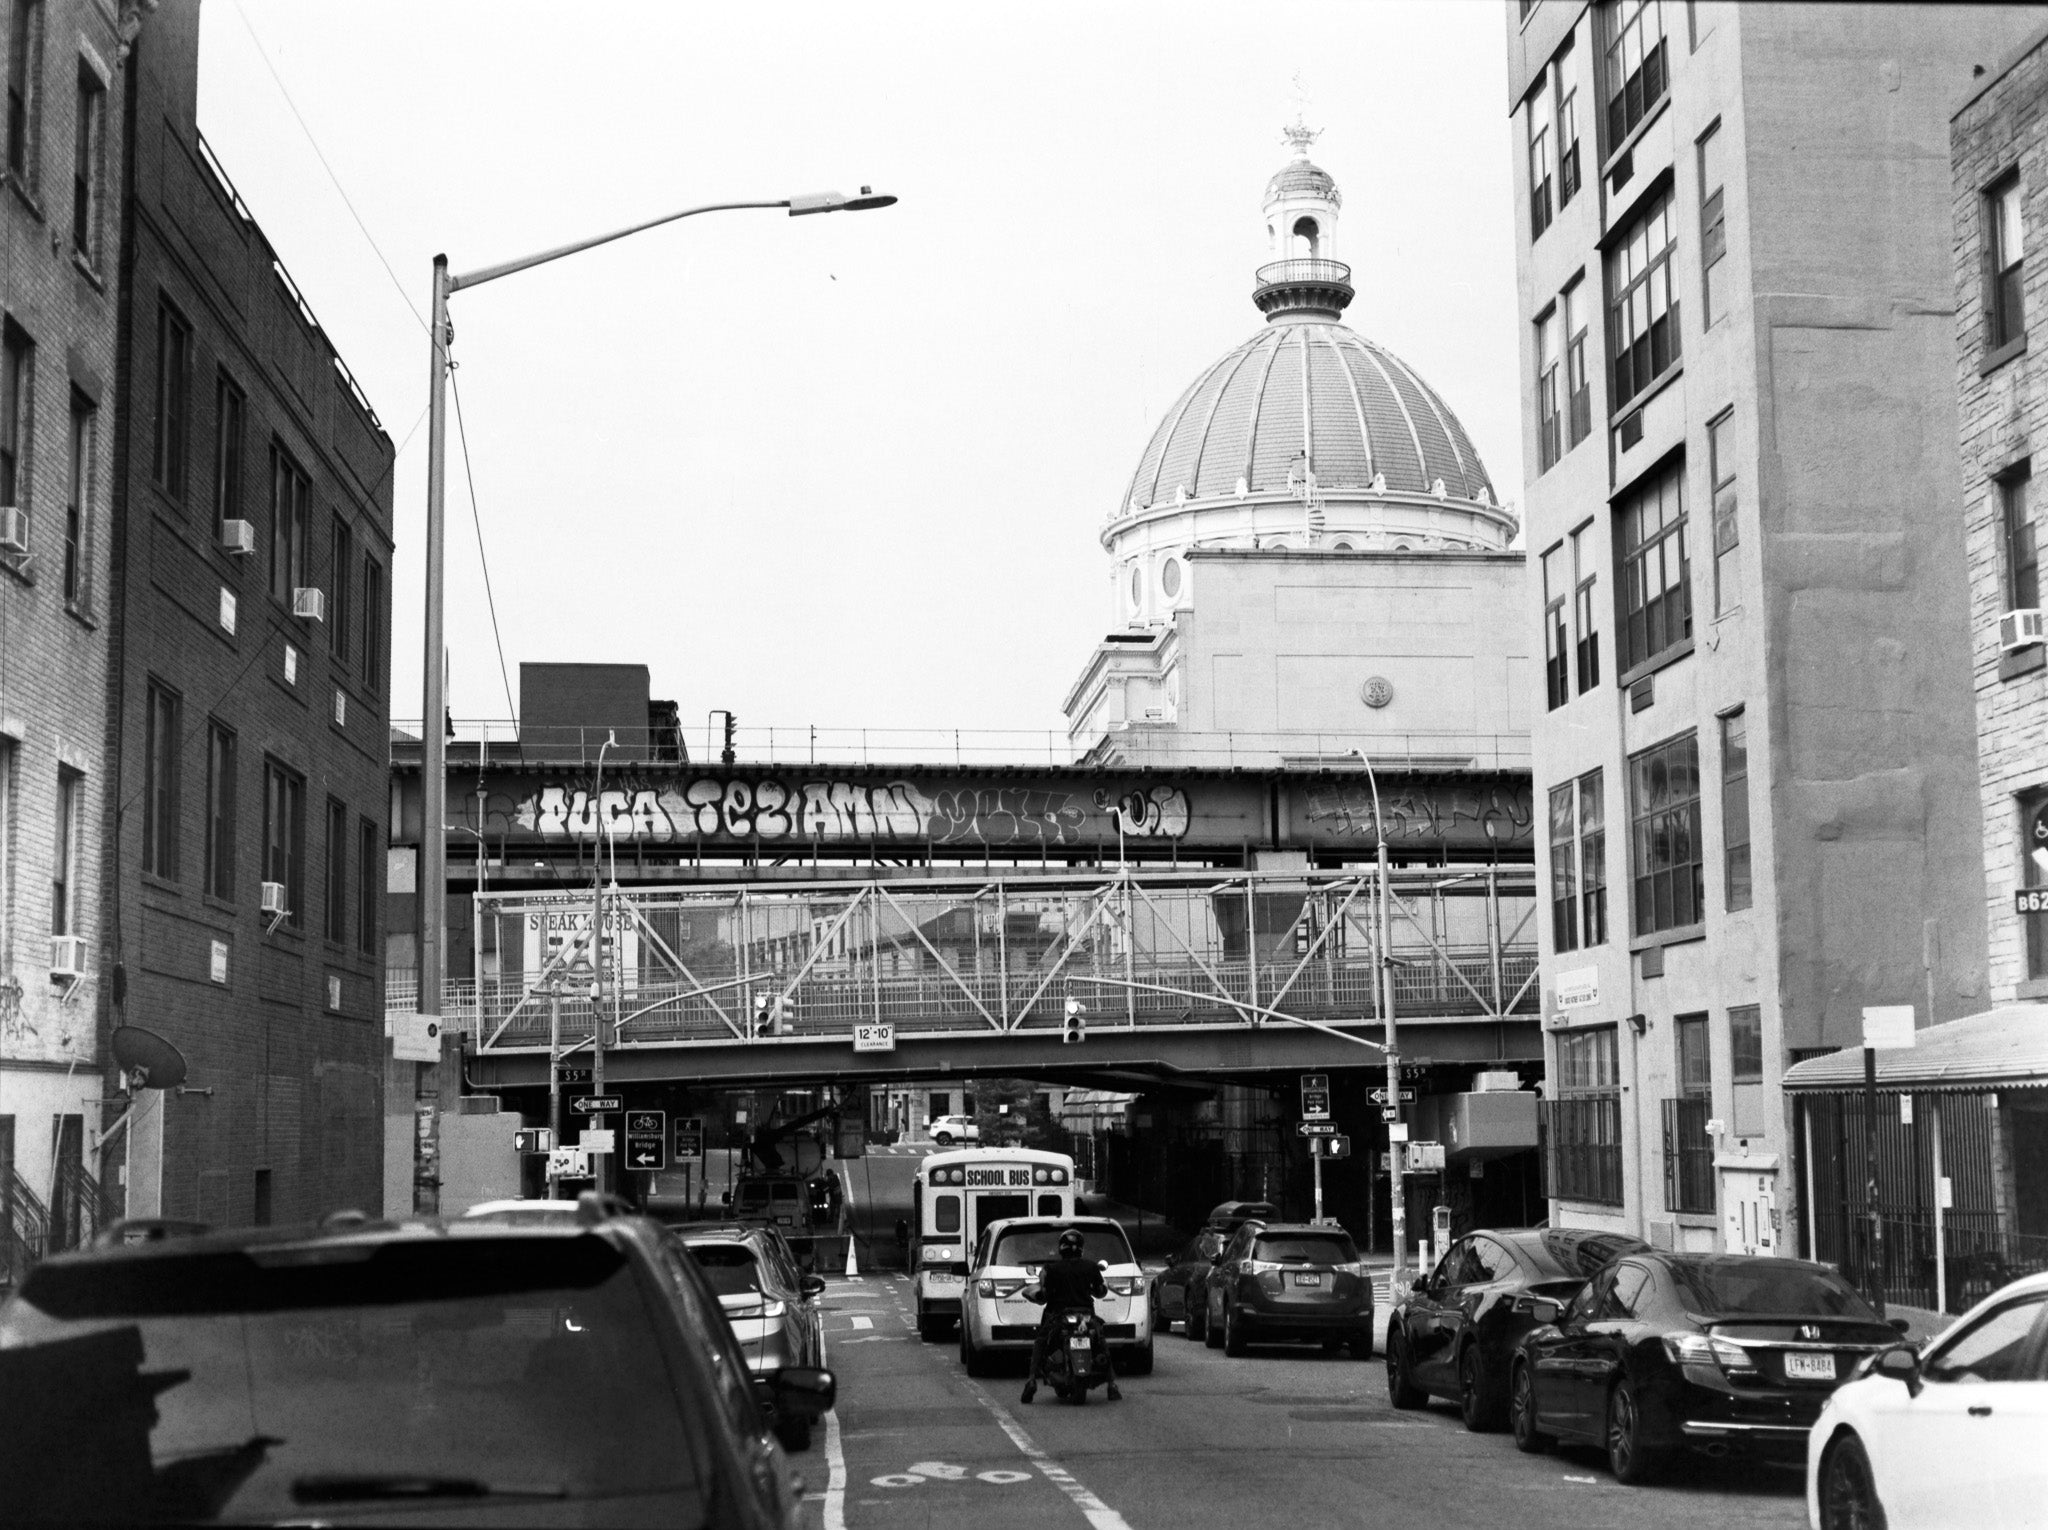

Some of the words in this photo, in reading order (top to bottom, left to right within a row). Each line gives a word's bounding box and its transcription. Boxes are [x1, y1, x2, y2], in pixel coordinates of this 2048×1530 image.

[2018, 892, 2048, 911] B62
[600, 1100, 616, 1108] WAY
[635, 1142, 656, 1150] Bridge
[967, 1170, 1006, 1186] SCHOOL
[1009, 1170, 1030, 1186] BUS
